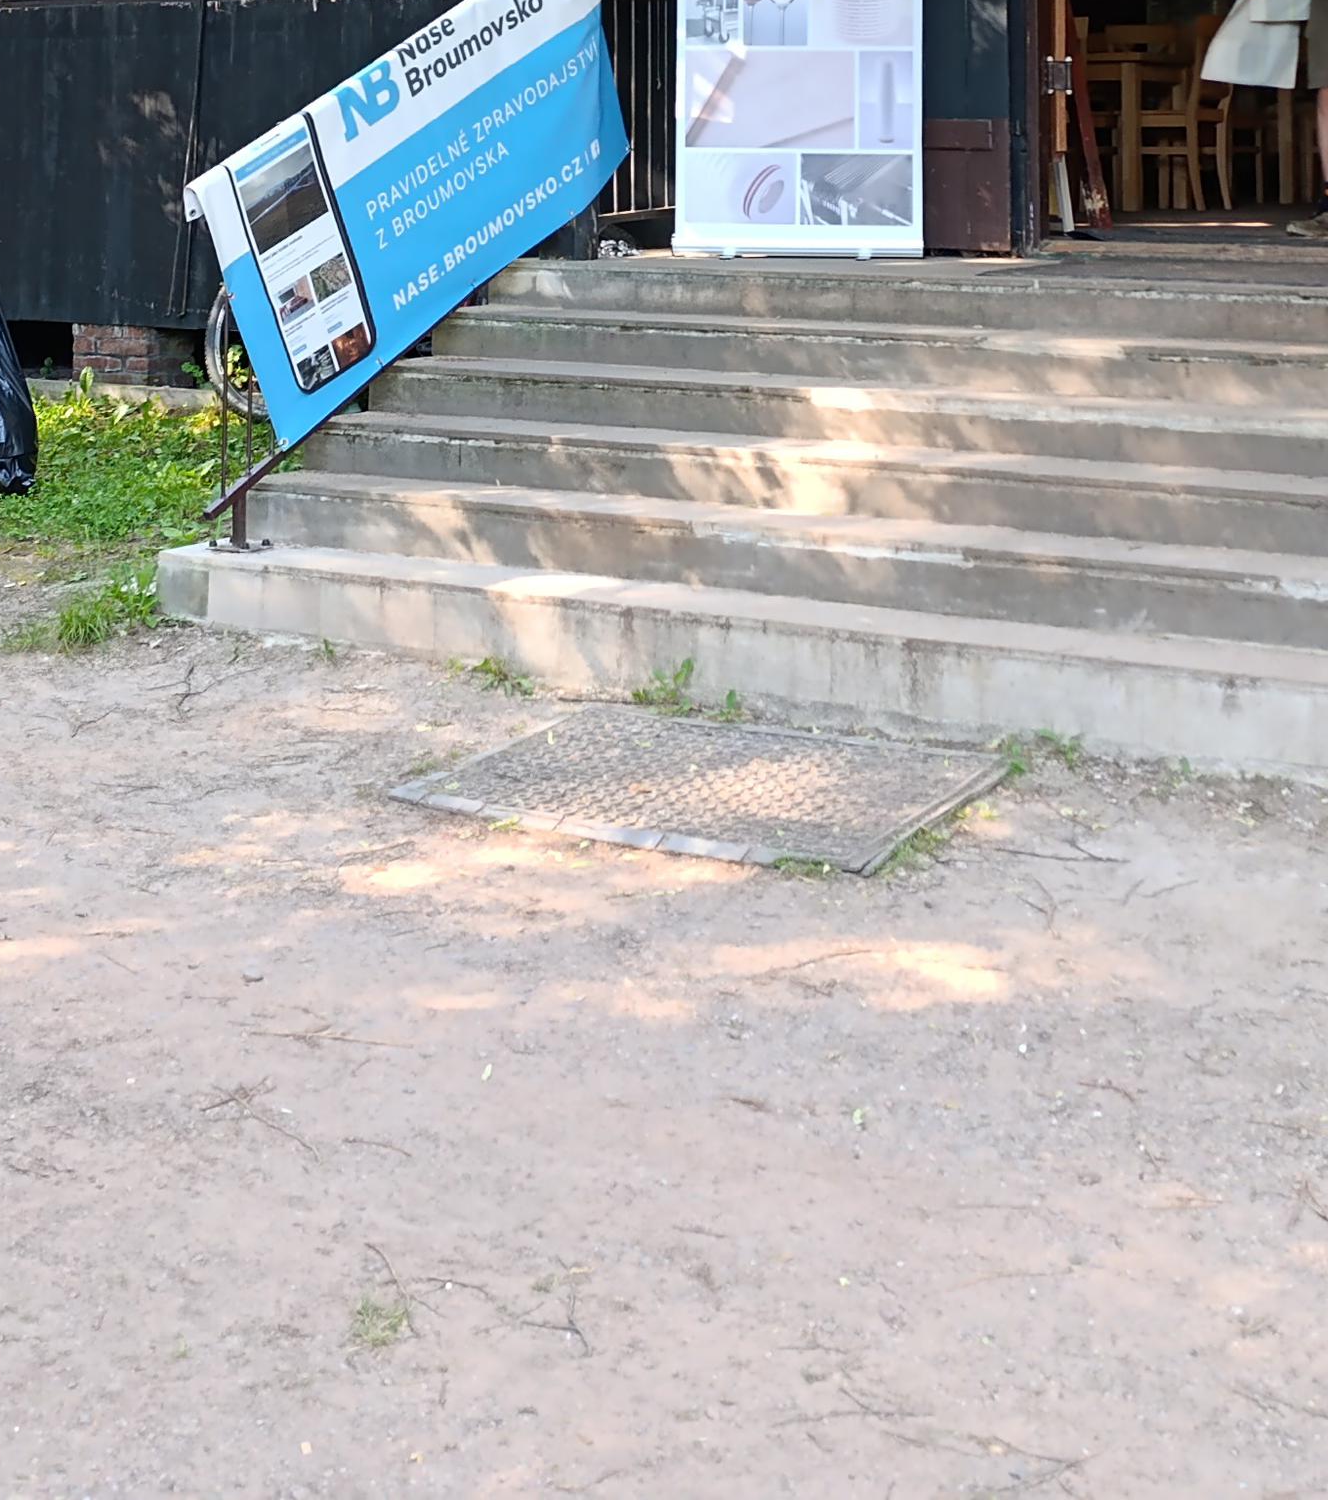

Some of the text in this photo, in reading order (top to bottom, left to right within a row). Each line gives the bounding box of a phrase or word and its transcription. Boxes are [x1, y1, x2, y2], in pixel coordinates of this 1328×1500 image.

[365, 35, 599, 221] PRAVIDELNÉ ZPRAVODAJSTVÍ
[375, 141, 510, 250] Z BROUMOVSKA
[392, 156, 584, 312] NASE.BROUMOVSKO.CZ
